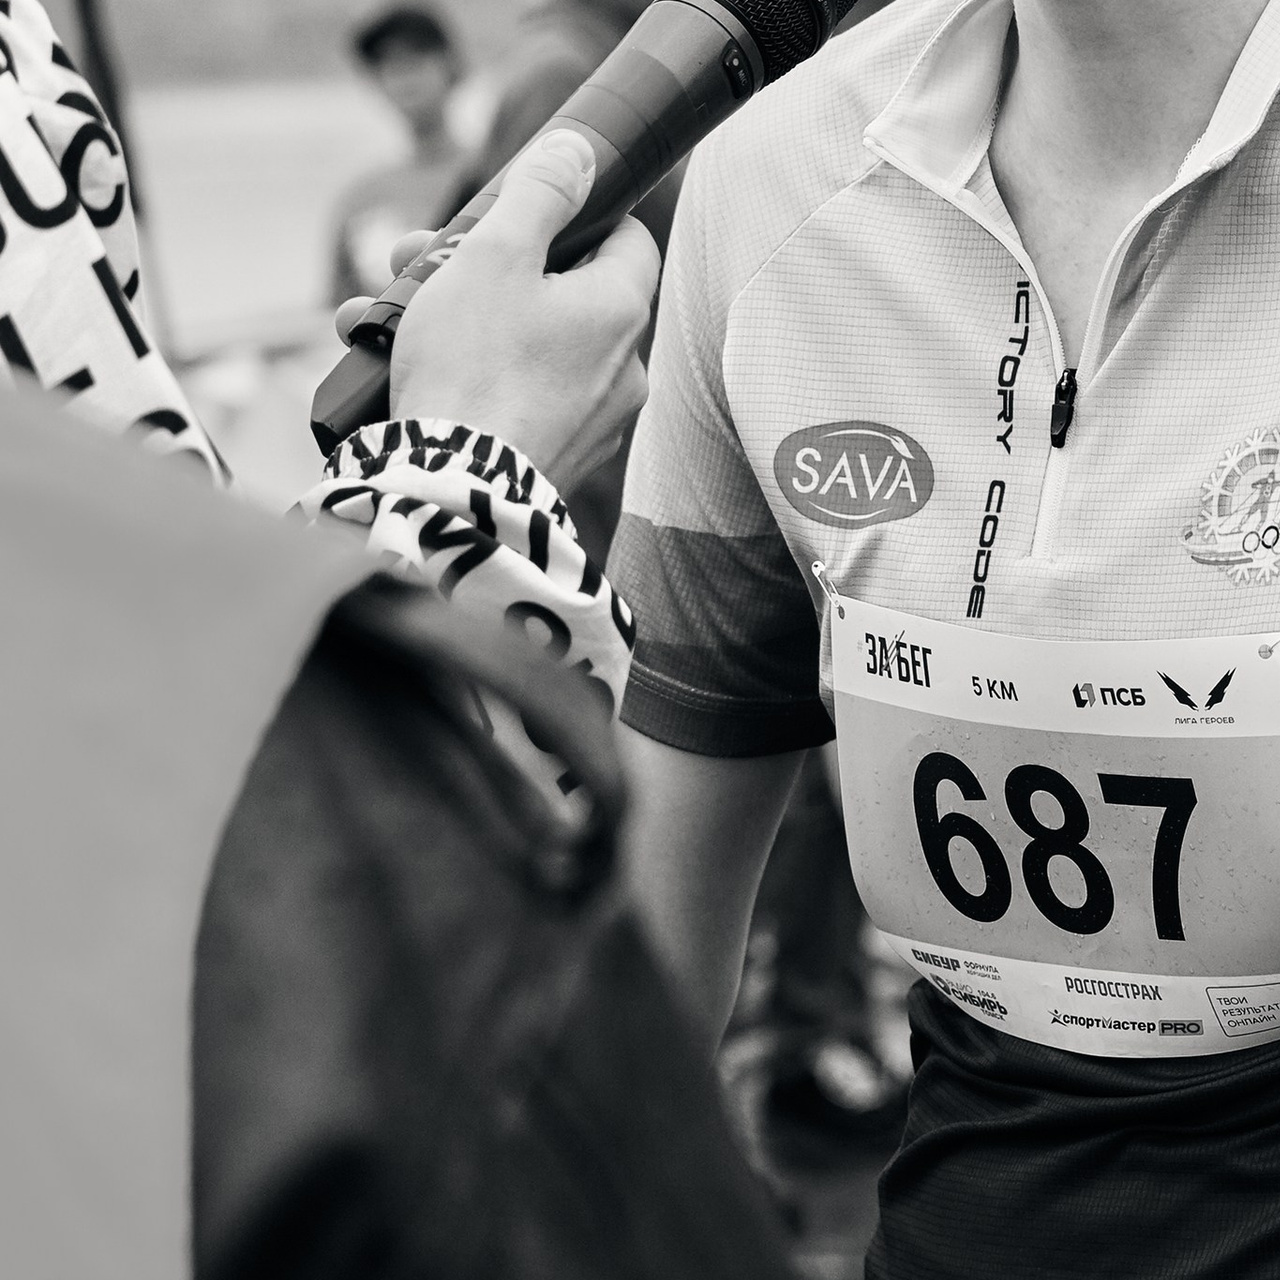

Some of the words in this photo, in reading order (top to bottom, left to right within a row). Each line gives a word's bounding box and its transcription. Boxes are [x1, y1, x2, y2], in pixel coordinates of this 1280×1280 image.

[996, 262, 1030, 455] ICTORY
[792, 447, 917, 503] SAVA
[966, 479, 1006, 619] CODE
[972, 676, 983, 696] 5
[1099, 687, 1146, 707] ПСБ
[1174, 717, 1198, 725] ЛИГА
[1200, 716, 1235, 725] ГЕРОЕВ
[912, 751, 1199, 942] 687
[911, 948, 961, 972] СИБУР
[963, 960, 1000, 974] ФОРМУЛА
[1064, 976, 1163, 1001] РОСГОССТРАХ
[951, 988, 1008, 1016] СИБИРЬ
[1217, 997, 1249, 1006] ТВОИ
[1160, 1022, 1201, 1035] PRO
[1228, 1014, 1277, 1028] ОНЛАЙН
